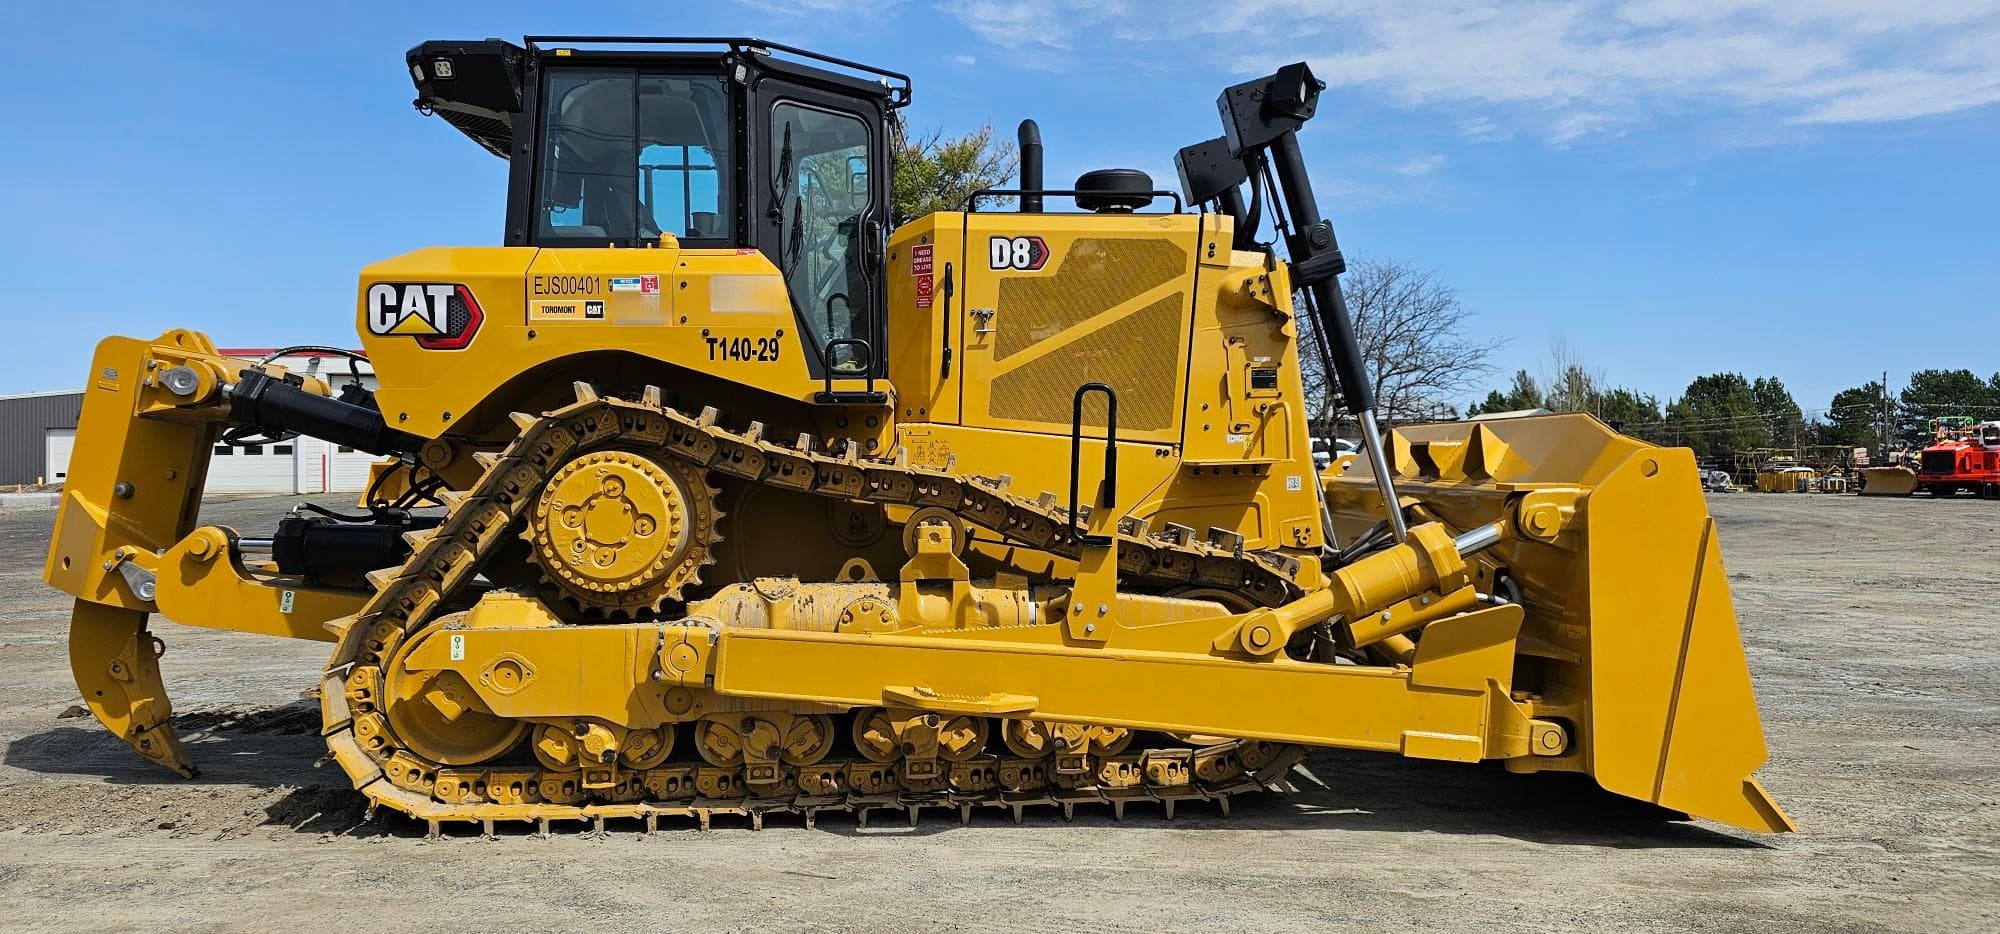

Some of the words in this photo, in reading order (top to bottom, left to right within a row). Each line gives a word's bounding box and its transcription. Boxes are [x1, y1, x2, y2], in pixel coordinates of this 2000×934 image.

[991, 237, 1030, 268] D8
[534, 276, 601, 295] EJS00401
[369, 284, 455, 334] CAT
[541, 305, 576, 314] TOROMONT
[586, 305, 602, 314] CAT
[706, 337, 779, 361] T140-29
